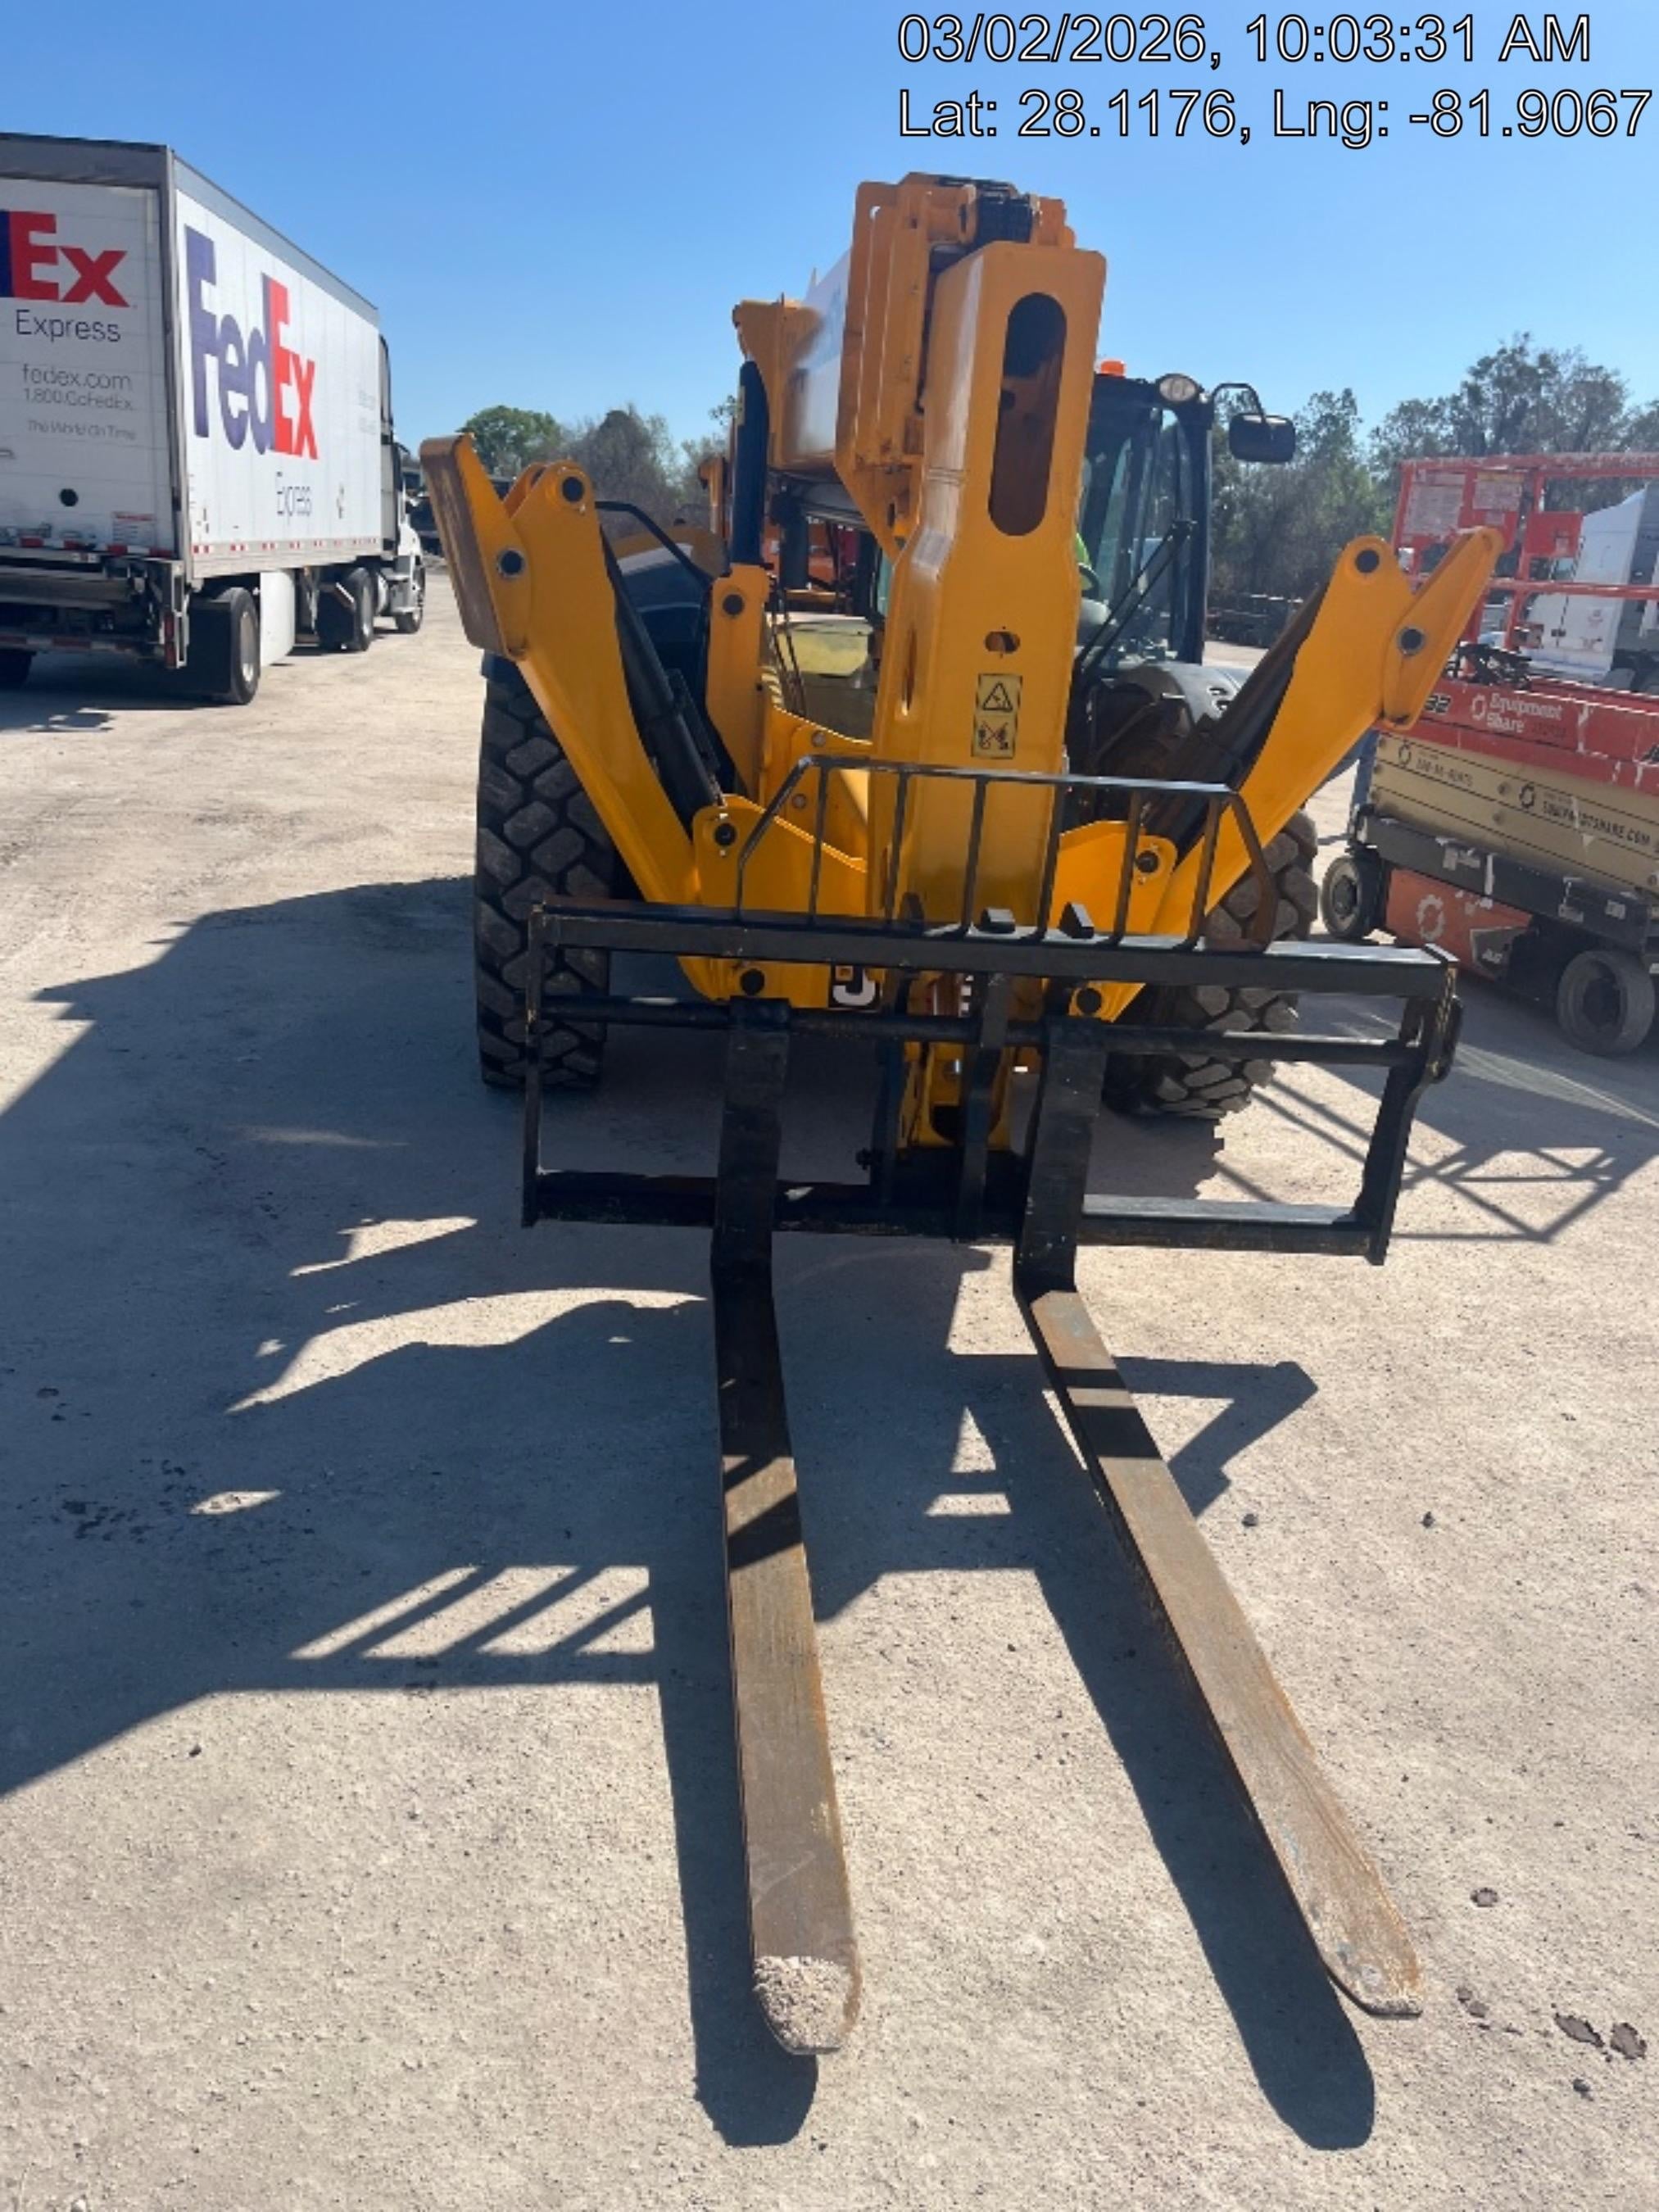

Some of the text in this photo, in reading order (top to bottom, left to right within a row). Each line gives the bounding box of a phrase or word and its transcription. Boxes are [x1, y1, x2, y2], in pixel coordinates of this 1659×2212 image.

[16, 309, 121, 343] Express
[184, 224, 318, 460] FedEx
[21, 363, 133, 392] fedex.com
[1489, 692, 1563, 721] Equipment
[1486, 712, 1525, 733] Share
